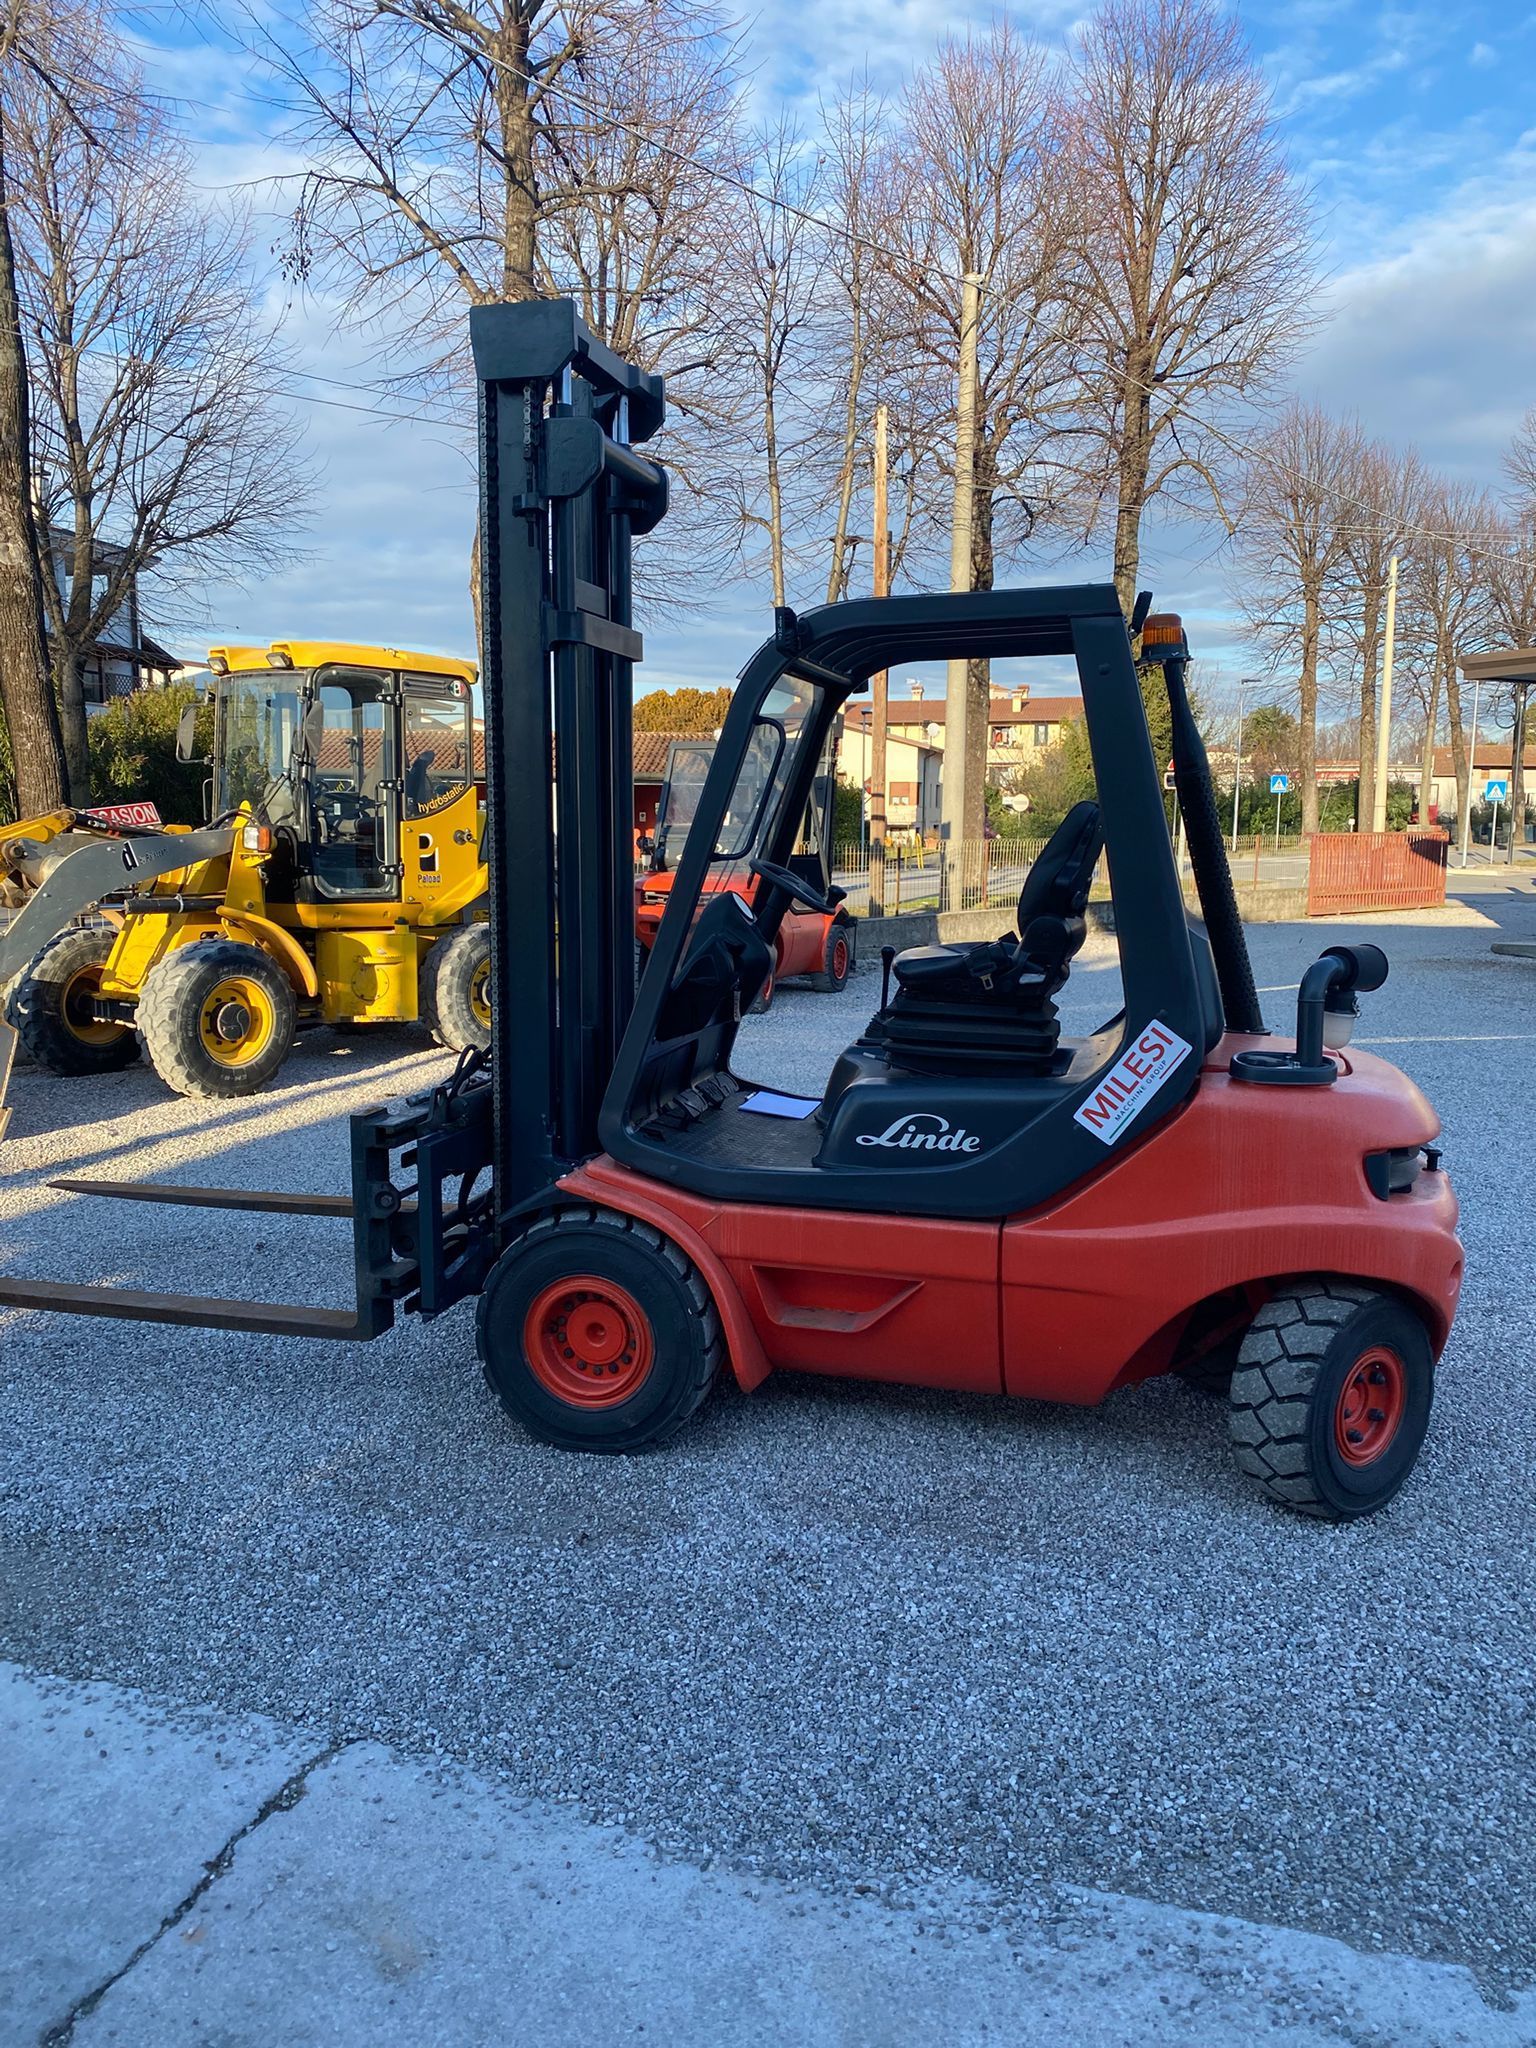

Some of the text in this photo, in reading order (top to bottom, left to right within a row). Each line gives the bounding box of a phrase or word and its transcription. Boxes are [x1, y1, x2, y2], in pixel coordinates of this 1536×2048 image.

[418, 783, 464, 813] hydrostatic
[1081, 1027, 1174, 1129] MILESI
[1115, 1060, 1167, 1121] MACCHINE GROUP
[856, 1113, 980, 1152] Linde
